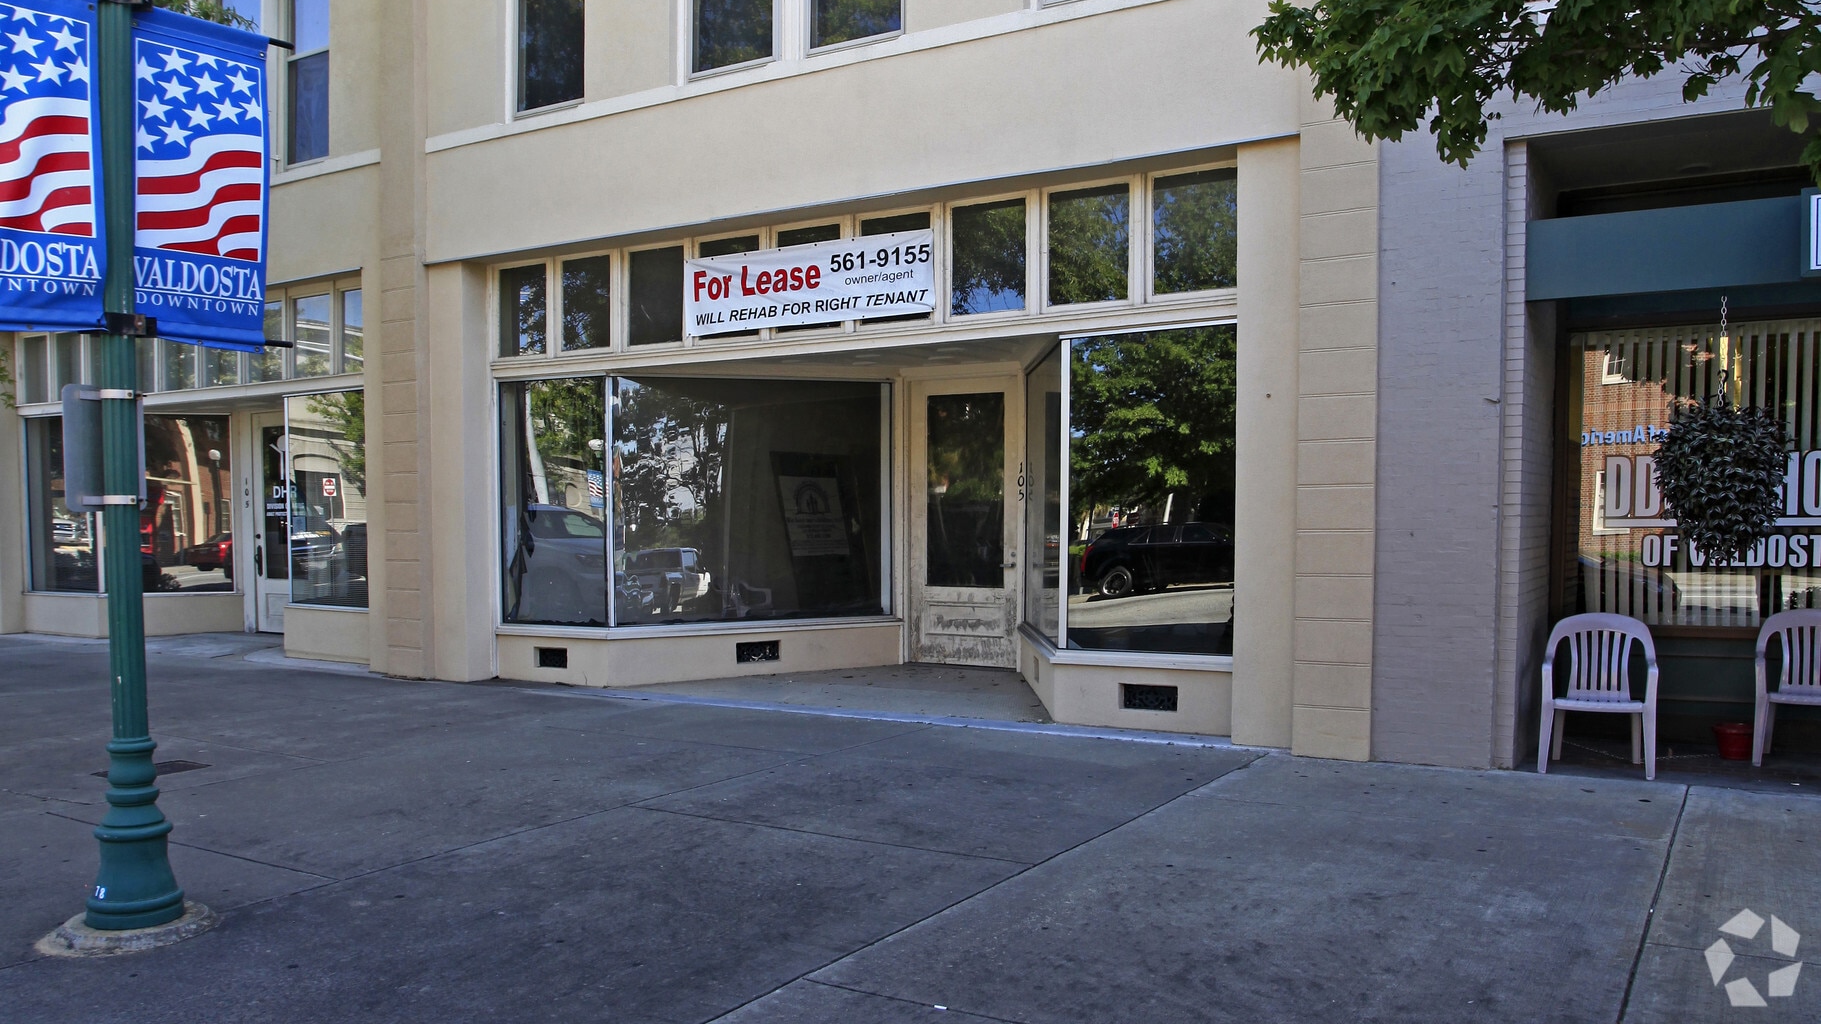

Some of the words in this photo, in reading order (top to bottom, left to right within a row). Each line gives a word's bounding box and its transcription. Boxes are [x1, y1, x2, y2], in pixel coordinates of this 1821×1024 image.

[0, 238, 102, 279] DOSTA
[829, 243, 931, 274] 561-9155
[0, 278, 97, 297] NTOWN
[133, 255, 263, 301] VALDOSTA
[693, 270, 732, 303] For
[740, 263, 822, 297] Lease
[844, 268, 914, 287] owner/agent
[136, 291, 259, 317] DOWNTOWN
[695, 310, 725, 326] WILL
[729, 304, 778, 322] REHAB
[781, 301, 811, 318] FOR
[815, 295, 861, 313] RIGHT
[866, 288, 929, 307] TENANT
[1017, 462, 1025, 502] 105
[1643, 534, 1679, 567] OF
